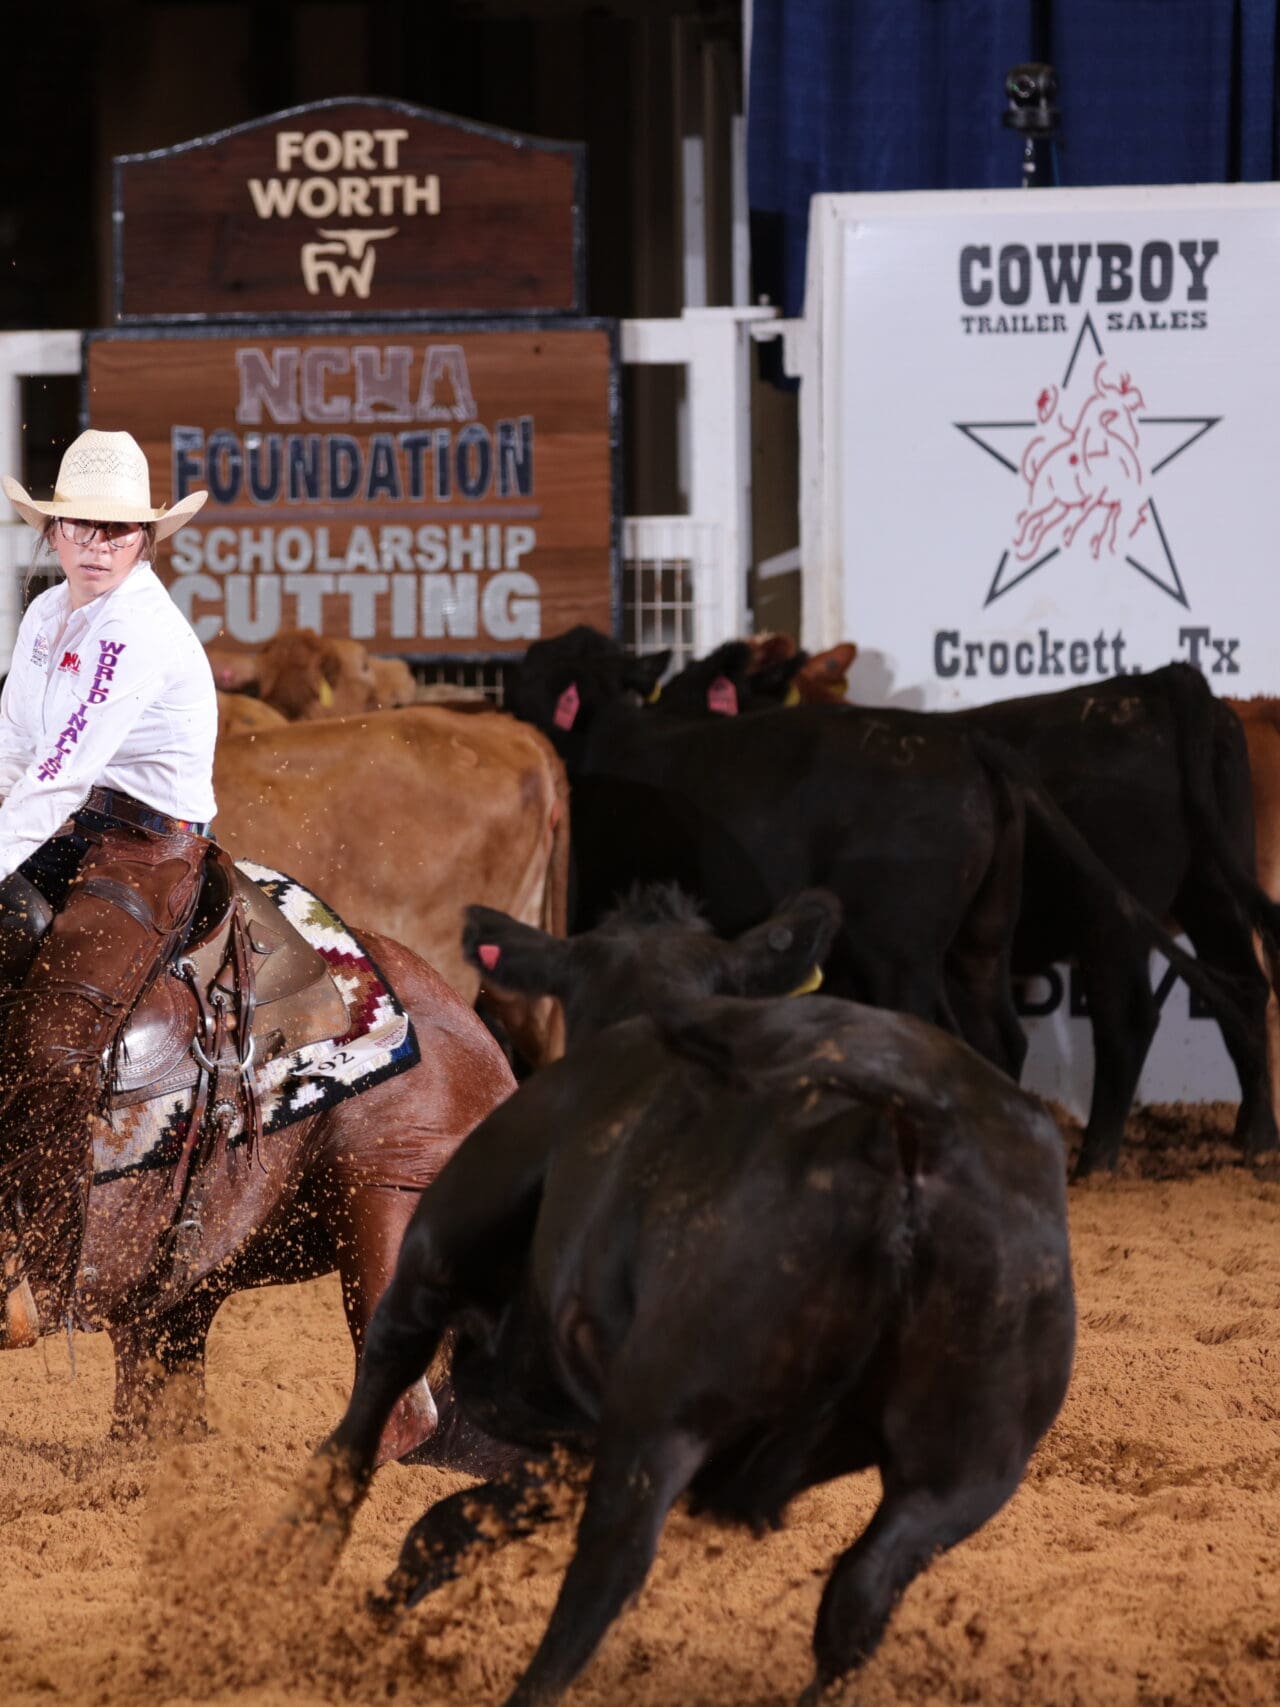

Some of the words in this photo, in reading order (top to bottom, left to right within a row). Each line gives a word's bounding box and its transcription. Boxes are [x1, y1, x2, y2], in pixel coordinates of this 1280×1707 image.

[276, 128, 409, 172] FORT
[248, 175, 441, 219] WORTH
[959, 239, 1219, 308] COWBOY
[961, 313, 1069, 335] TRAILER
[1107, 310, 1208, 331] SALES
[235, 344, 478, 425] NCHA
[171, 415, 535, 504] FOUNDATION
[169, 524, 536, 575] SCHOLARSHIP
[168, 572, 541, 645] CUTTING
[86, 639, 127, 704] WORLD
[1178, 626, 1241, 674] Tx
[37, 702, 89, 783] INALIST
